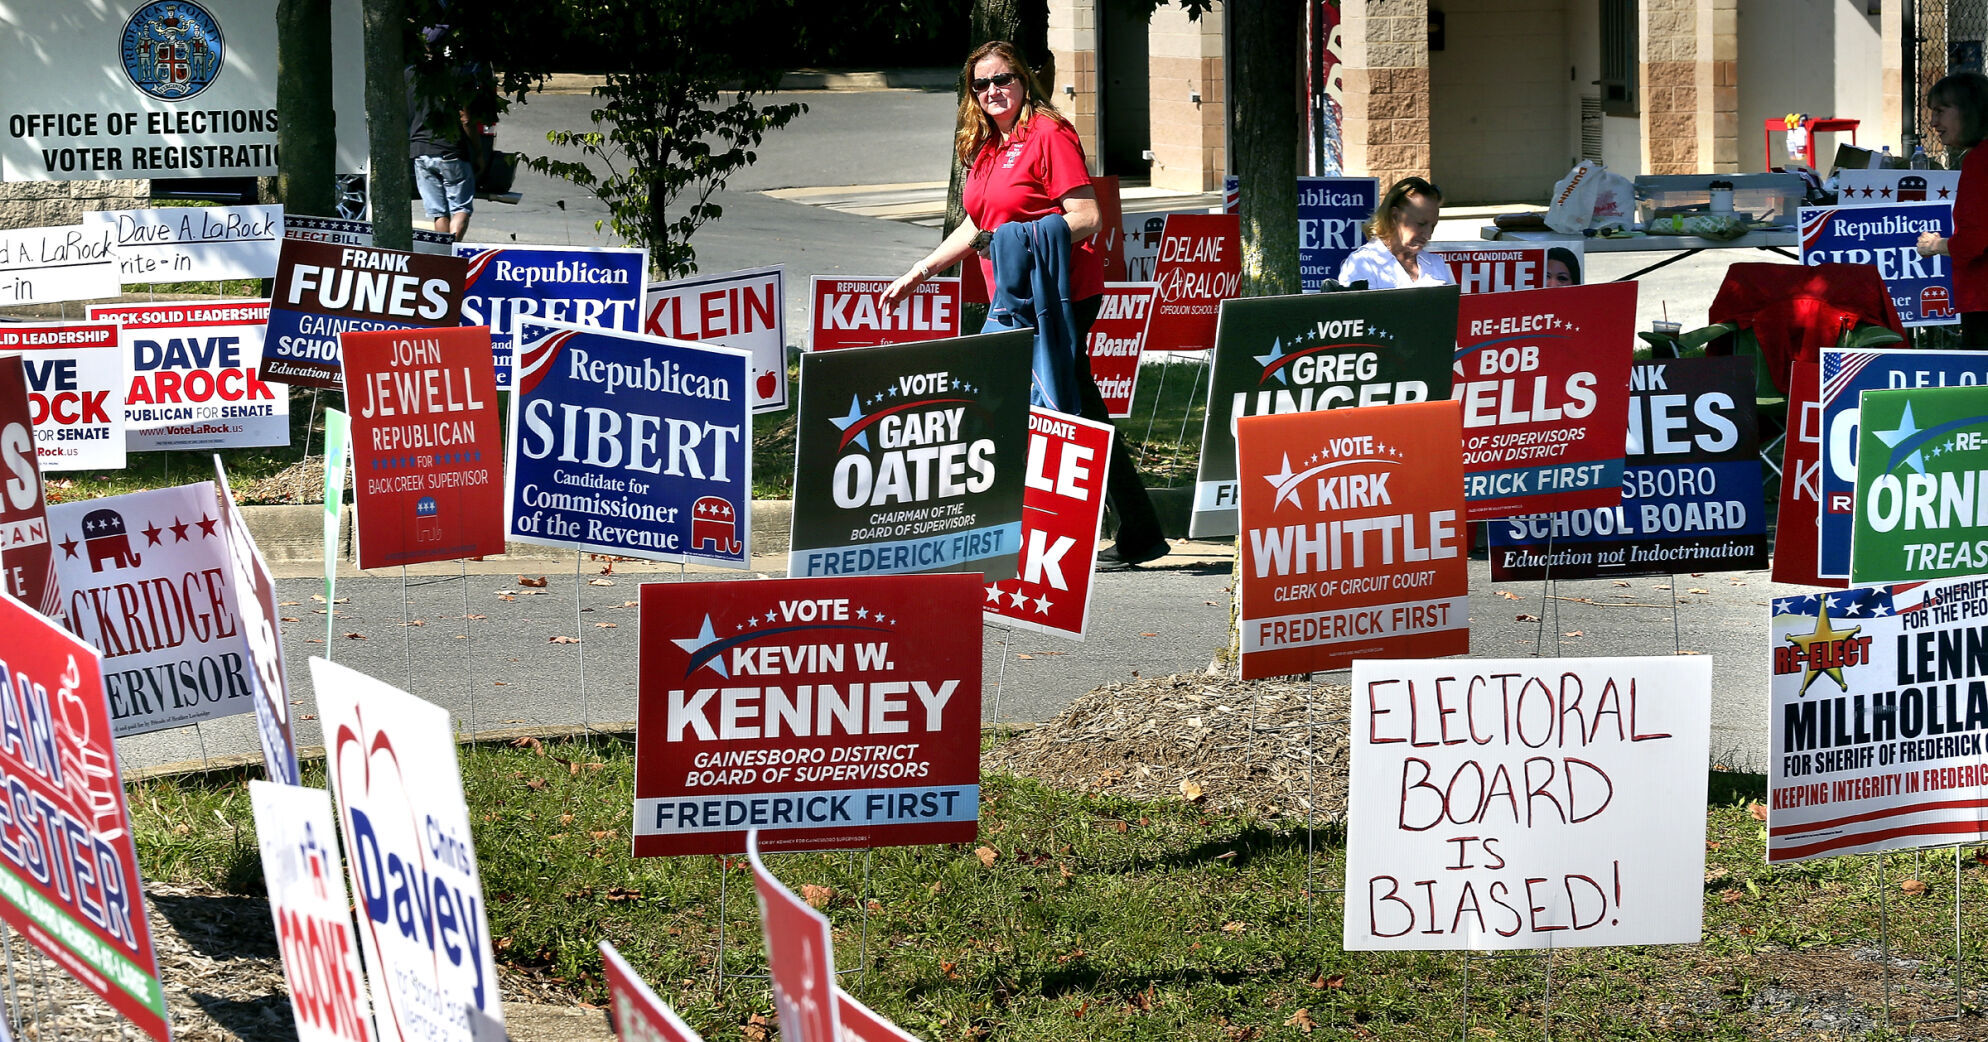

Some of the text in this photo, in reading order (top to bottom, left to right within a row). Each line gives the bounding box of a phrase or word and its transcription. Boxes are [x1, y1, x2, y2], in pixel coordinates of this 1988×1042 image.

[9, 109, 278, 138] OFFICE OF ELECTIONS
[42, 144, 278, 172] VOTER REGISTRATI
[117, 212, 275, 244] Dave A. LaRock
[332, 234, 362, 245] BILL
[1834, 215, 1942, 241] Republican
[19, 244, 34, 262] A.
[41, 230, 116, 264] LaRock
[341, 249, 411, 273] FRANK
[1162, 236, 1225, 263] DELANE
[1472, 251, 1523, 261] CANDIDATE
[119, 252, 192, 274] rite-in
[495, 260, 629, 287] Republican
[288, 264, 451, 320] FUNES
[644, 283, 775, 342] KLEIN
[822, 293, 952, 331] KAHLE
[1160, 305, 1214, 316] OPEQUON SCHOOL
[1471, 314, 1555, 336] RE-ELECT
[28, 331, 110, 345] LEADERSHIP
[1317, 319, 1365, 340] VOTE
[134, 337, 240, 371] DAVE
[391, 338, 441, 368] JOHN
[1092, 332, 1143, 357] Board
[269, 361, 331, 381] Education
[569, 347, 731, 402] Republican
[1292, 352, 1378, 385] GREG
[1479, 346, 1539, 375] BOB
[124, 368, 275, 405] AROCK
[361, 367, 484, 419] JEWELL
[900, 371, 948, 397] VOTE
[196, 407, 218, 419] FOR
[221, 404, 273, 419] SENATE
[57, 427, 110, 441] SENATE
[139, 423, 243, 436] www.VoteLaRock.us
[372, 420, 476, 452] REPUBLICAN
[523, 399, 740, 484] SIBERT
[879, 407, 966, 450] GARY
[1468, 427, 1586, 450] OF SUPERVISORS
[1329, 435, 1374, 458] VOTE
[1507, 443, 1568, 462] DISTRICT
[417, 455, 433, 469] FOR
[832, 438, 996, 509] OATES
[368, 469, 489, 495] BACK CREEK SUPERVISOR
[553, 469, 650, 496] Candidate for
[1538, 464, 1604, 490] FIRST
[522, 483, 679, 525] Commissioner
[1317, 472, 1392, 512] KIRK
[850, 513, 976, 542] BOARD OF SUPERVISORS
[870, 502, 965, 526] CHAIRMAN OF THE
[1508, 500, 1747, 540] SCHOOL BOARD
[517, 512, 680, 551] of the Revenue
[1249, 509, 1458, 579] WHITTLE
[807, 538, 946, 576] FREDERICK
[952, 529, 1004, 560] FIRST
[1503, 541, 1756, 569] Education not Indoctrination
[1274, 570, 1436, 602] CLERK OF CIRCUIT COURT
[1922, 590, 1932, 608] A
[68, 567, 237, 659] CKRIDGE
[778, 598, 850, 623] VOTE
[1259, 602, 1451, 646] FREDERICK FIRST
[1903, 611, 1928, 631] FOR
[1932, 603, 1959, 625] THE
[732, 641, 895, 676] KEVIN W.
[1774, 636, 1872, 675] RE-ELECT
[666, 679, 961, 743] KENNEY
[1368, 672, 1673, 749] ELECTORAL
[694, 743, 919, 769] GAINESBORO DISTRICT
[1784, 733, 1982, 777] FOR SHERIFF OF FREDERICK
[685, 761, 930, 787] BOARD OF SUPERVISORS
[1399, 756, 1614, 832] BOARD
[1772, 781, 1831, 810] KEEPING
[1832, 773, 1902, 803] INTEGRITY
[1905, 771, 1919, 793] IN
[656, 791, 960, 829] FREDERICK FIRST
[1445, 836, 1505, 871] IS
[350, 806, 485, 1011] Davey
[1369, 860, 1621, 937] BIASED!
